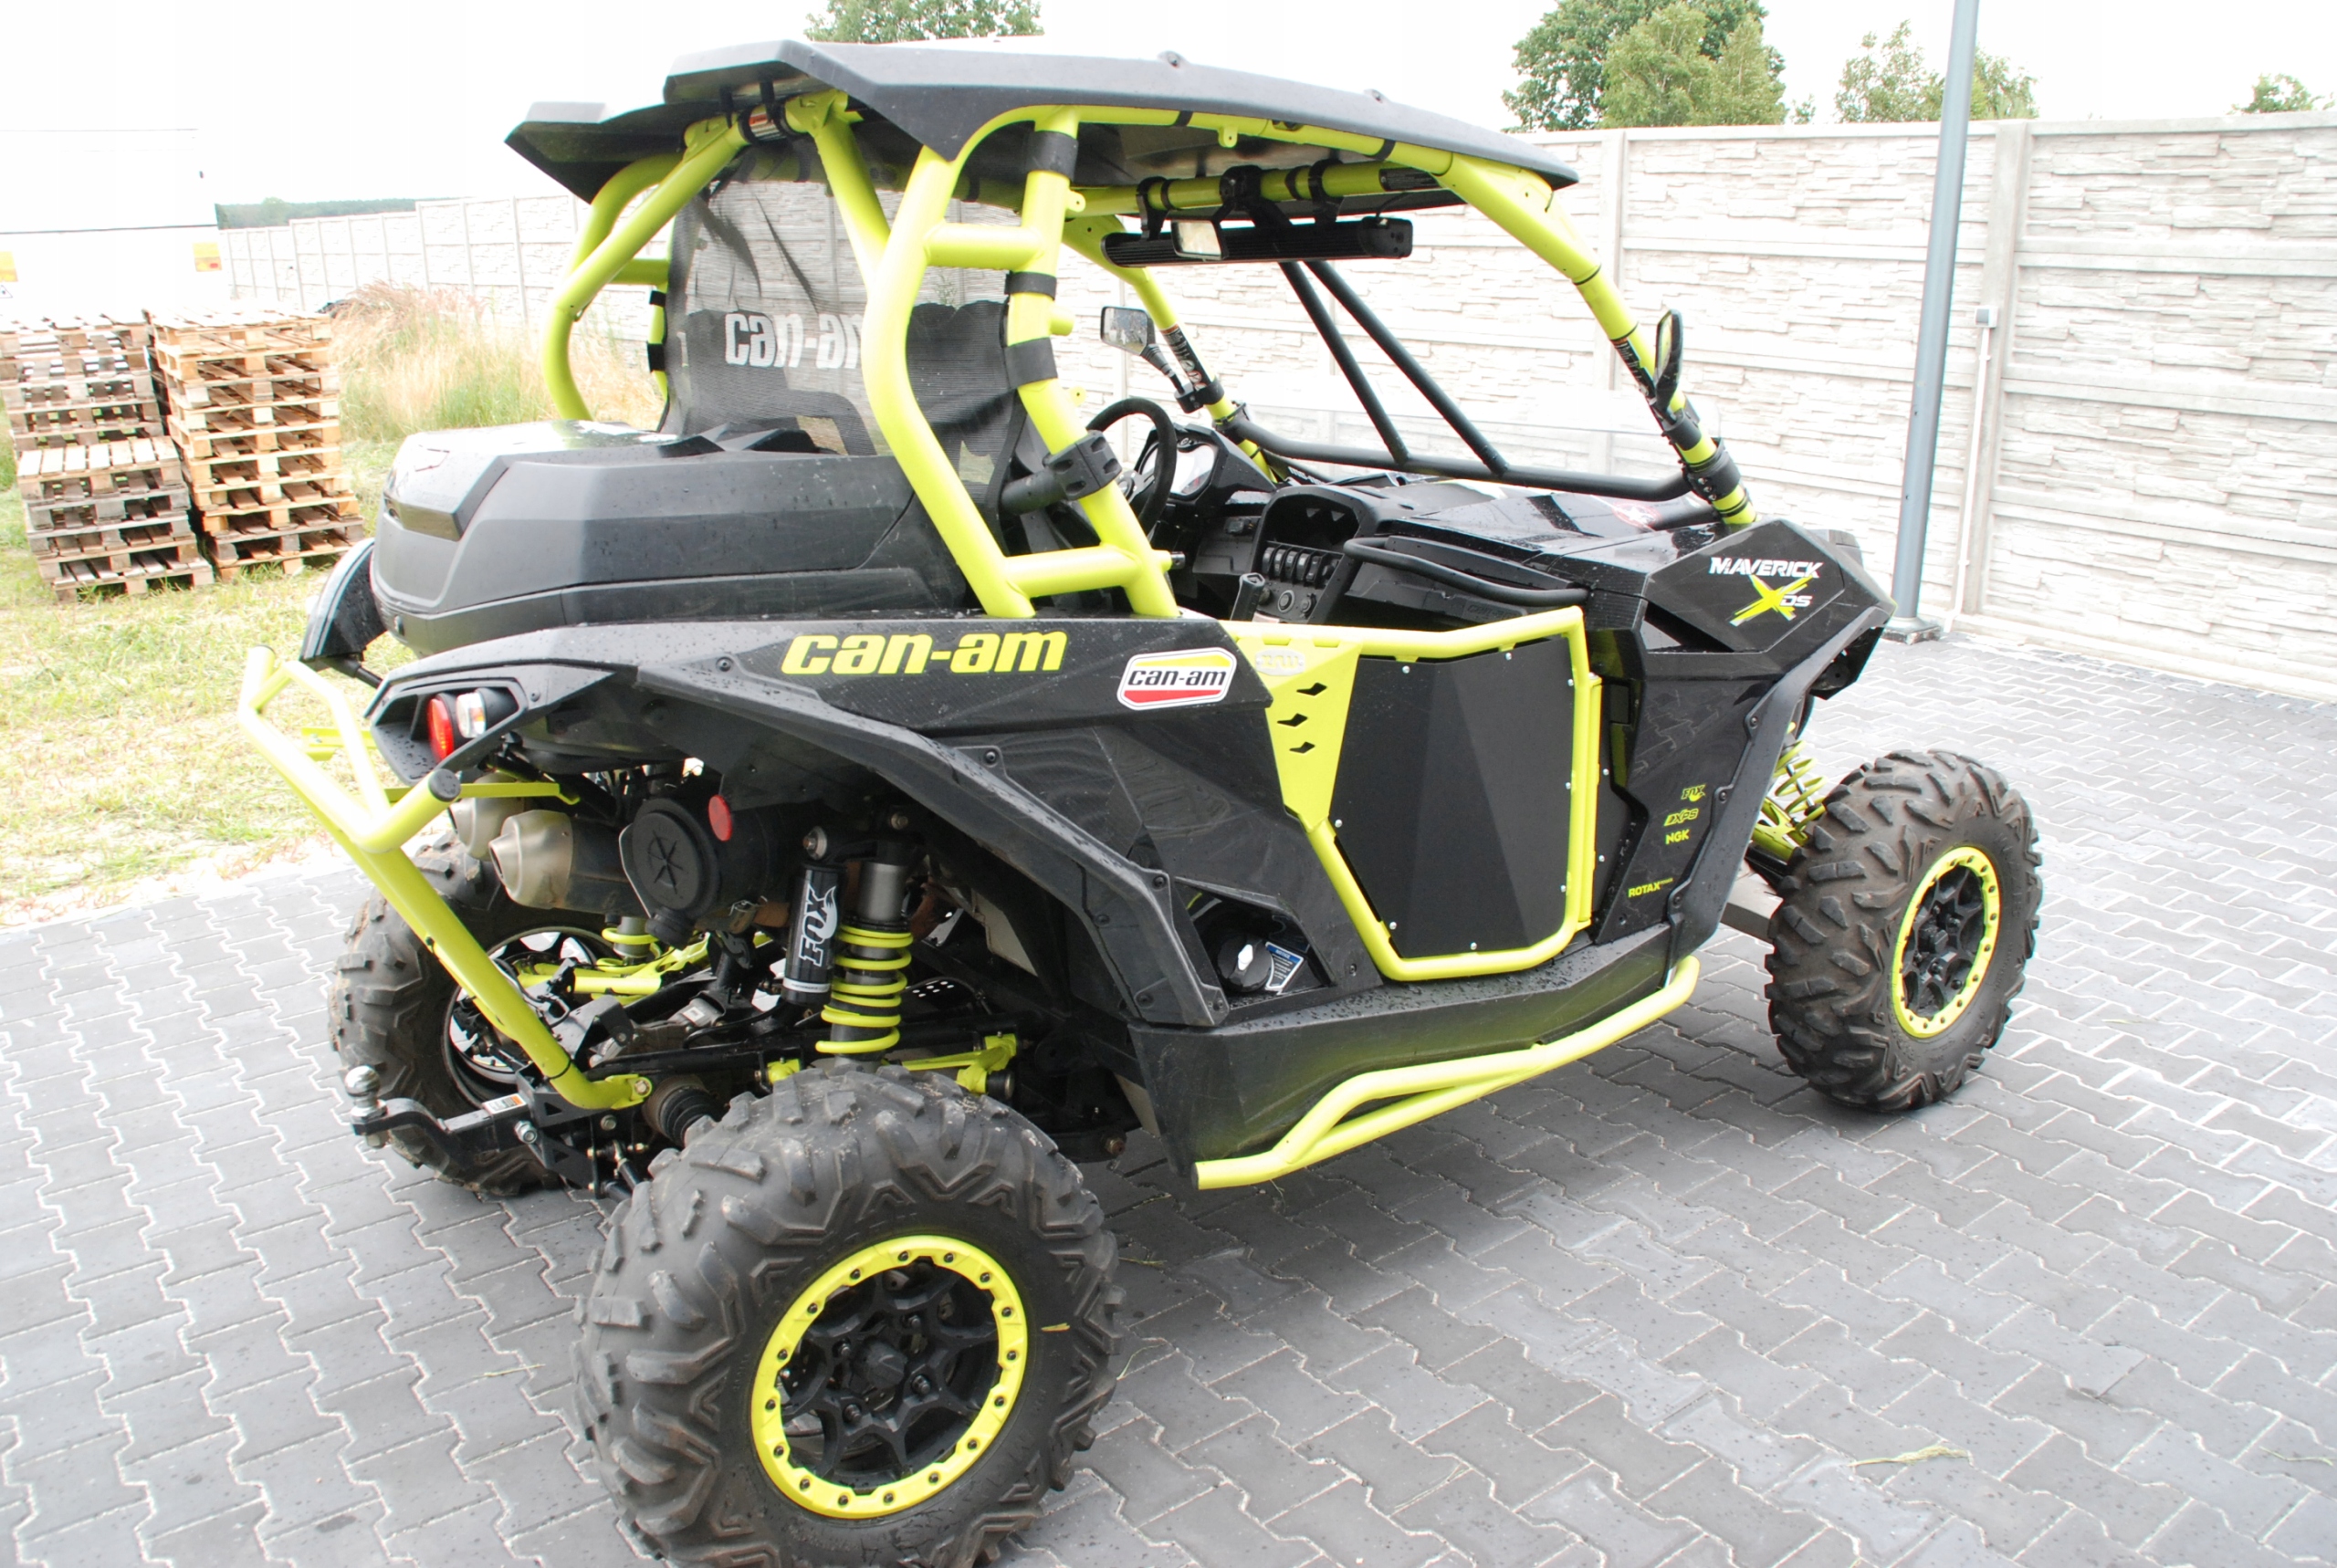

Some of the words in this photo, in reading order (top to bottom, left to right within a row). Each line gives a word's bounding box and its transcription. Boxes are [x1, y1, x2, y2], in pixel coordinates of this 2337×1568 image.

[1708, 557, 1823, 579] MAVERICK
[781, 631, 1068, 675] can-am
[1127, 664, 1227, 686] can-am
[1665, 829, 1690, 845] NGK
[1628, 881, 1661, 898] ROTAX
[799, 883, 838, 967] FOX
